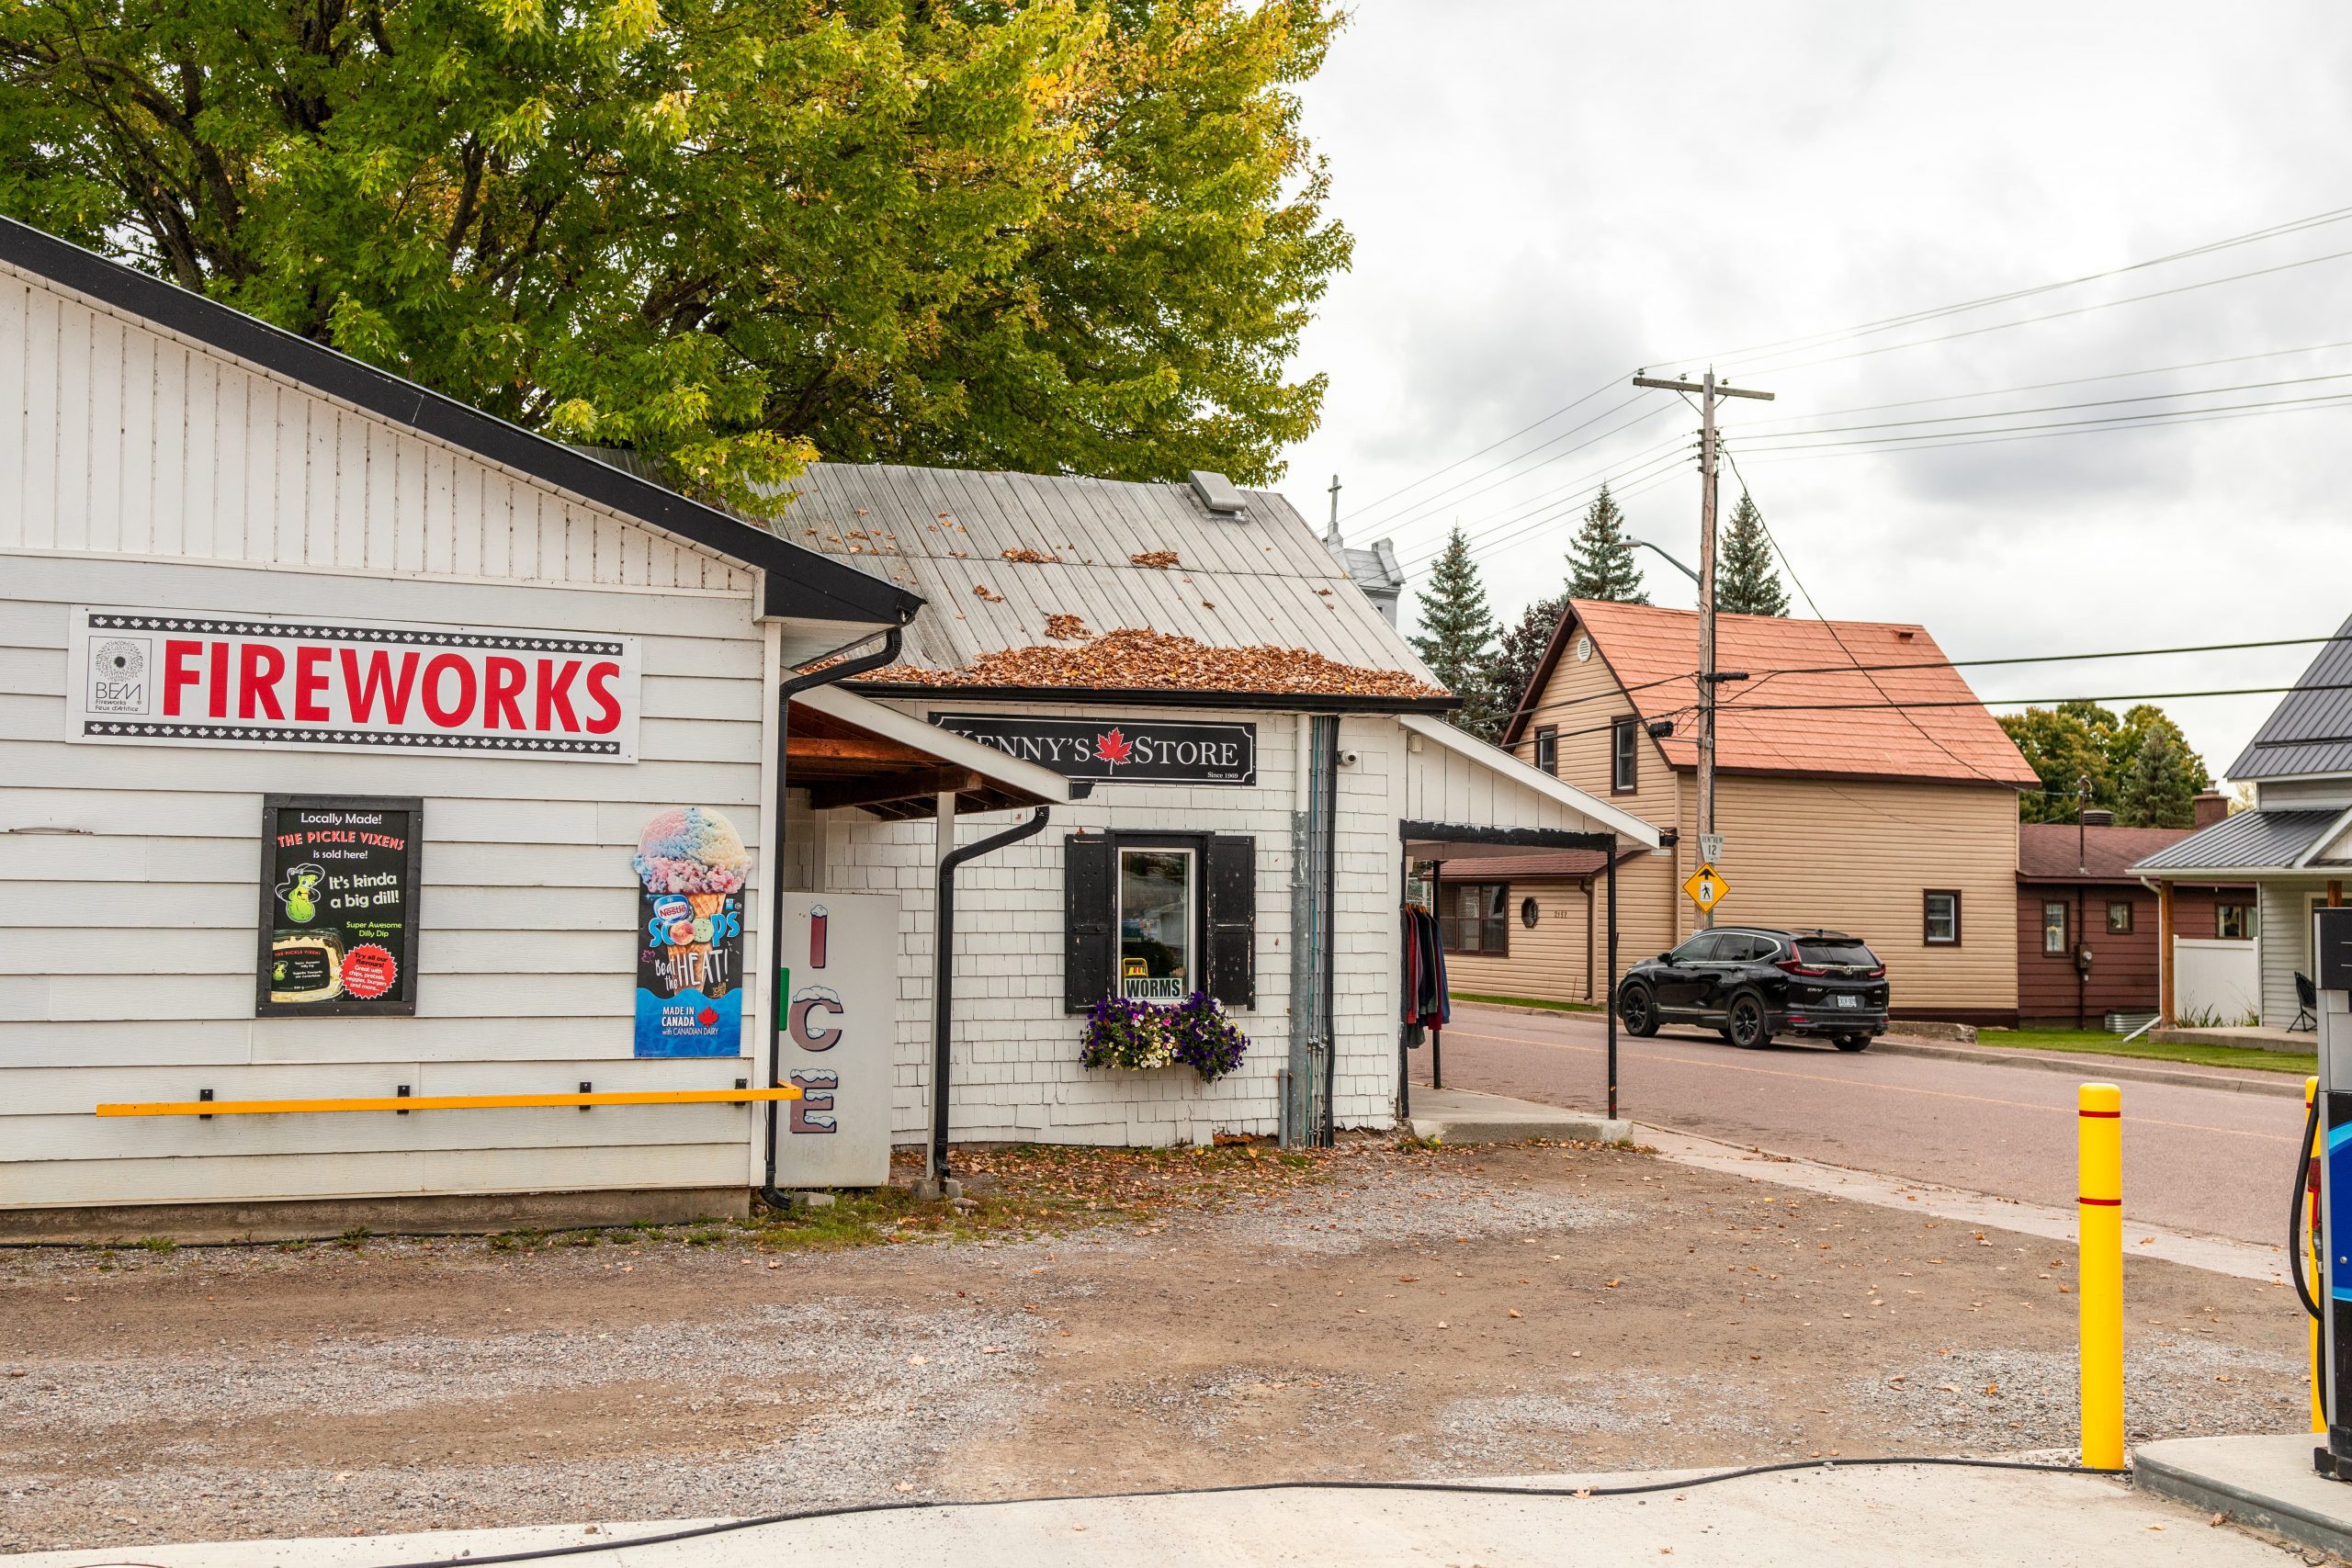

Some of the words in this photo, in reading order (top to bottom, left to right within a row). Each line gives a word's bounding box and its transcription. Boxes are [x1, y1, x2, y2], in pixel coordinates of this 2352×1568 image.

[96, 682, 141, 701] BEM
[163, 639, 622, 734] FIREWORKS
[949, 729, 1091, 762] NNY'S
[1135, 736, 1238, 766] STORE
[300, 812, 343, 826] Locally
[345, 813, 382, 825] Made!
[277, 832, 303, 848] THE
[307, 830, 356, 844] PICKLE
[359, 831, 405, 851] VIXENS
[312, 850, 320, 859] is
[322, 850, 342, 859] sold
[344, 850, 368, 860] here!
[1708, 844, 1717, 855] 12
[329, 875, 350, 890] It's
[353, 872, 398, 888] kinda
[331, 897, 342, 908] a
[345, 894, 369, 908] big
[372, 889, 400, 905] dill!
[346, 920, 368, 929] Super
[359, 930, 375, 938] Dilly
[376, 930, 390, 938] Dip
[654, 956, 676, 976] Beat
[676, 948, 729, 987] HEAT!
[664, 974, 679, 991] the
[1125, 979, 1181, 998] WORMS
[662, 1006, 684, 1015] MADE
[686, 1006, 695, 1015] IN
[788, 904, 844, 1134] ICE
[662, 1016, 695, 1027] CANADA
[662, 1027, 673, 1035] with
[673, 1028, 703, 1036] CANADIAN
[703, 1027, 719, 1036] DAIRY
